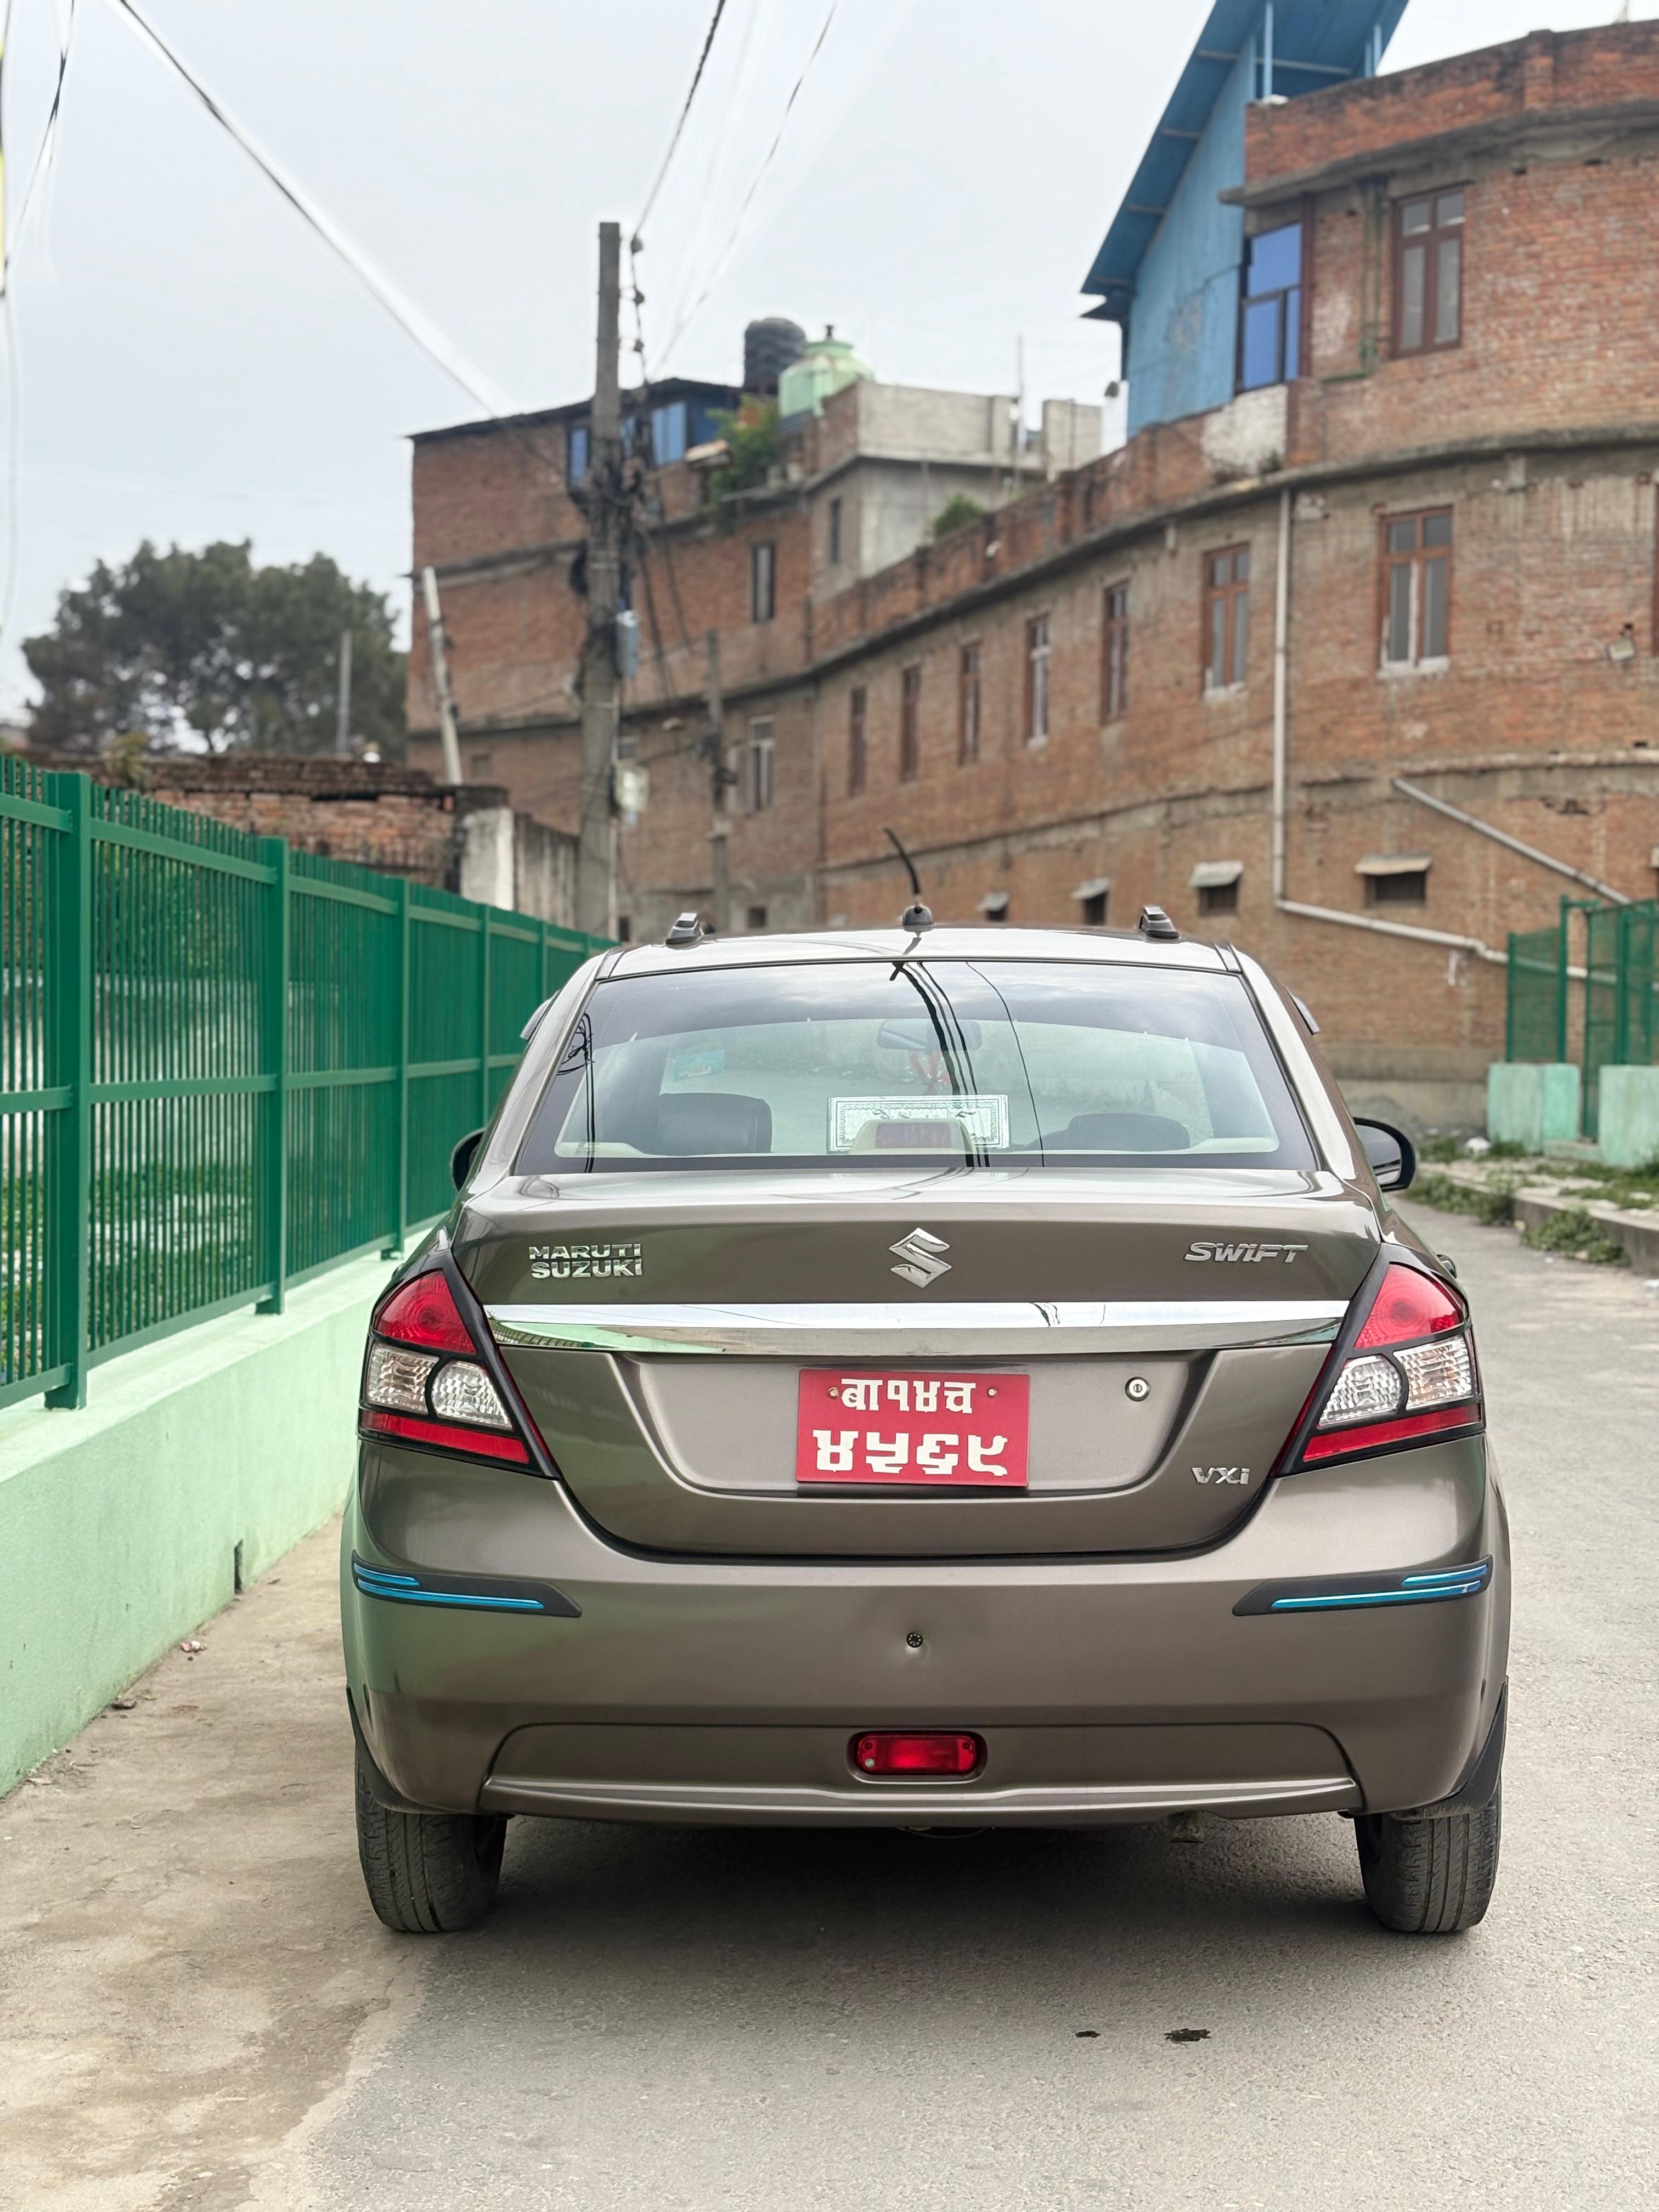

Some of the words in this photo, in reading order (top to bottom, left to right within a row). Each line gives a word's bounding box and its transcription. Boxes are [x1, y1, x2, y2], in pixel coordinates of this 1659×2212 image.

[528, 1243, 641, 1260] MARUTI
[1184, 1242, 1309, 1263] SWIFT
[531, 1258, 643, 1279] SUZUKI
